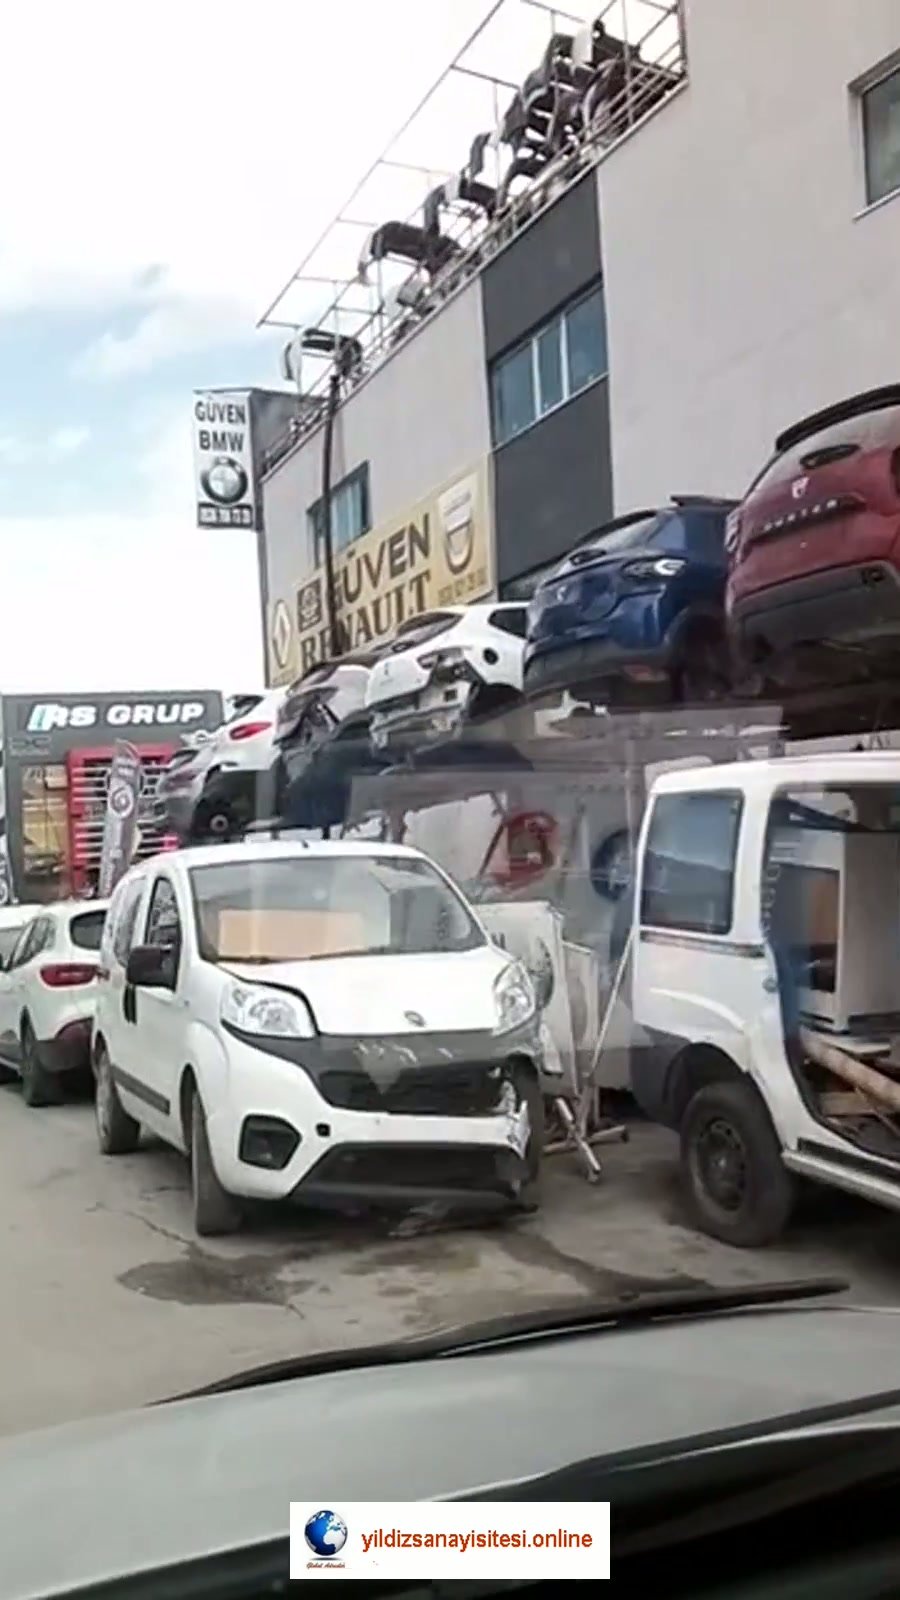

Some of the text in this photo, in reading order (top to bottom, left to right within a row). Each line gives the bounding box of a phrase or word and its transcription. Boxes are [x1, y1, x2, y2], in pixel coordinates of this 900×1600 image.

[194, 394, 246, 425] GÜVEN
[199, 429, 244, 452] BMW
[106, 702, 205, 725] GRUP
